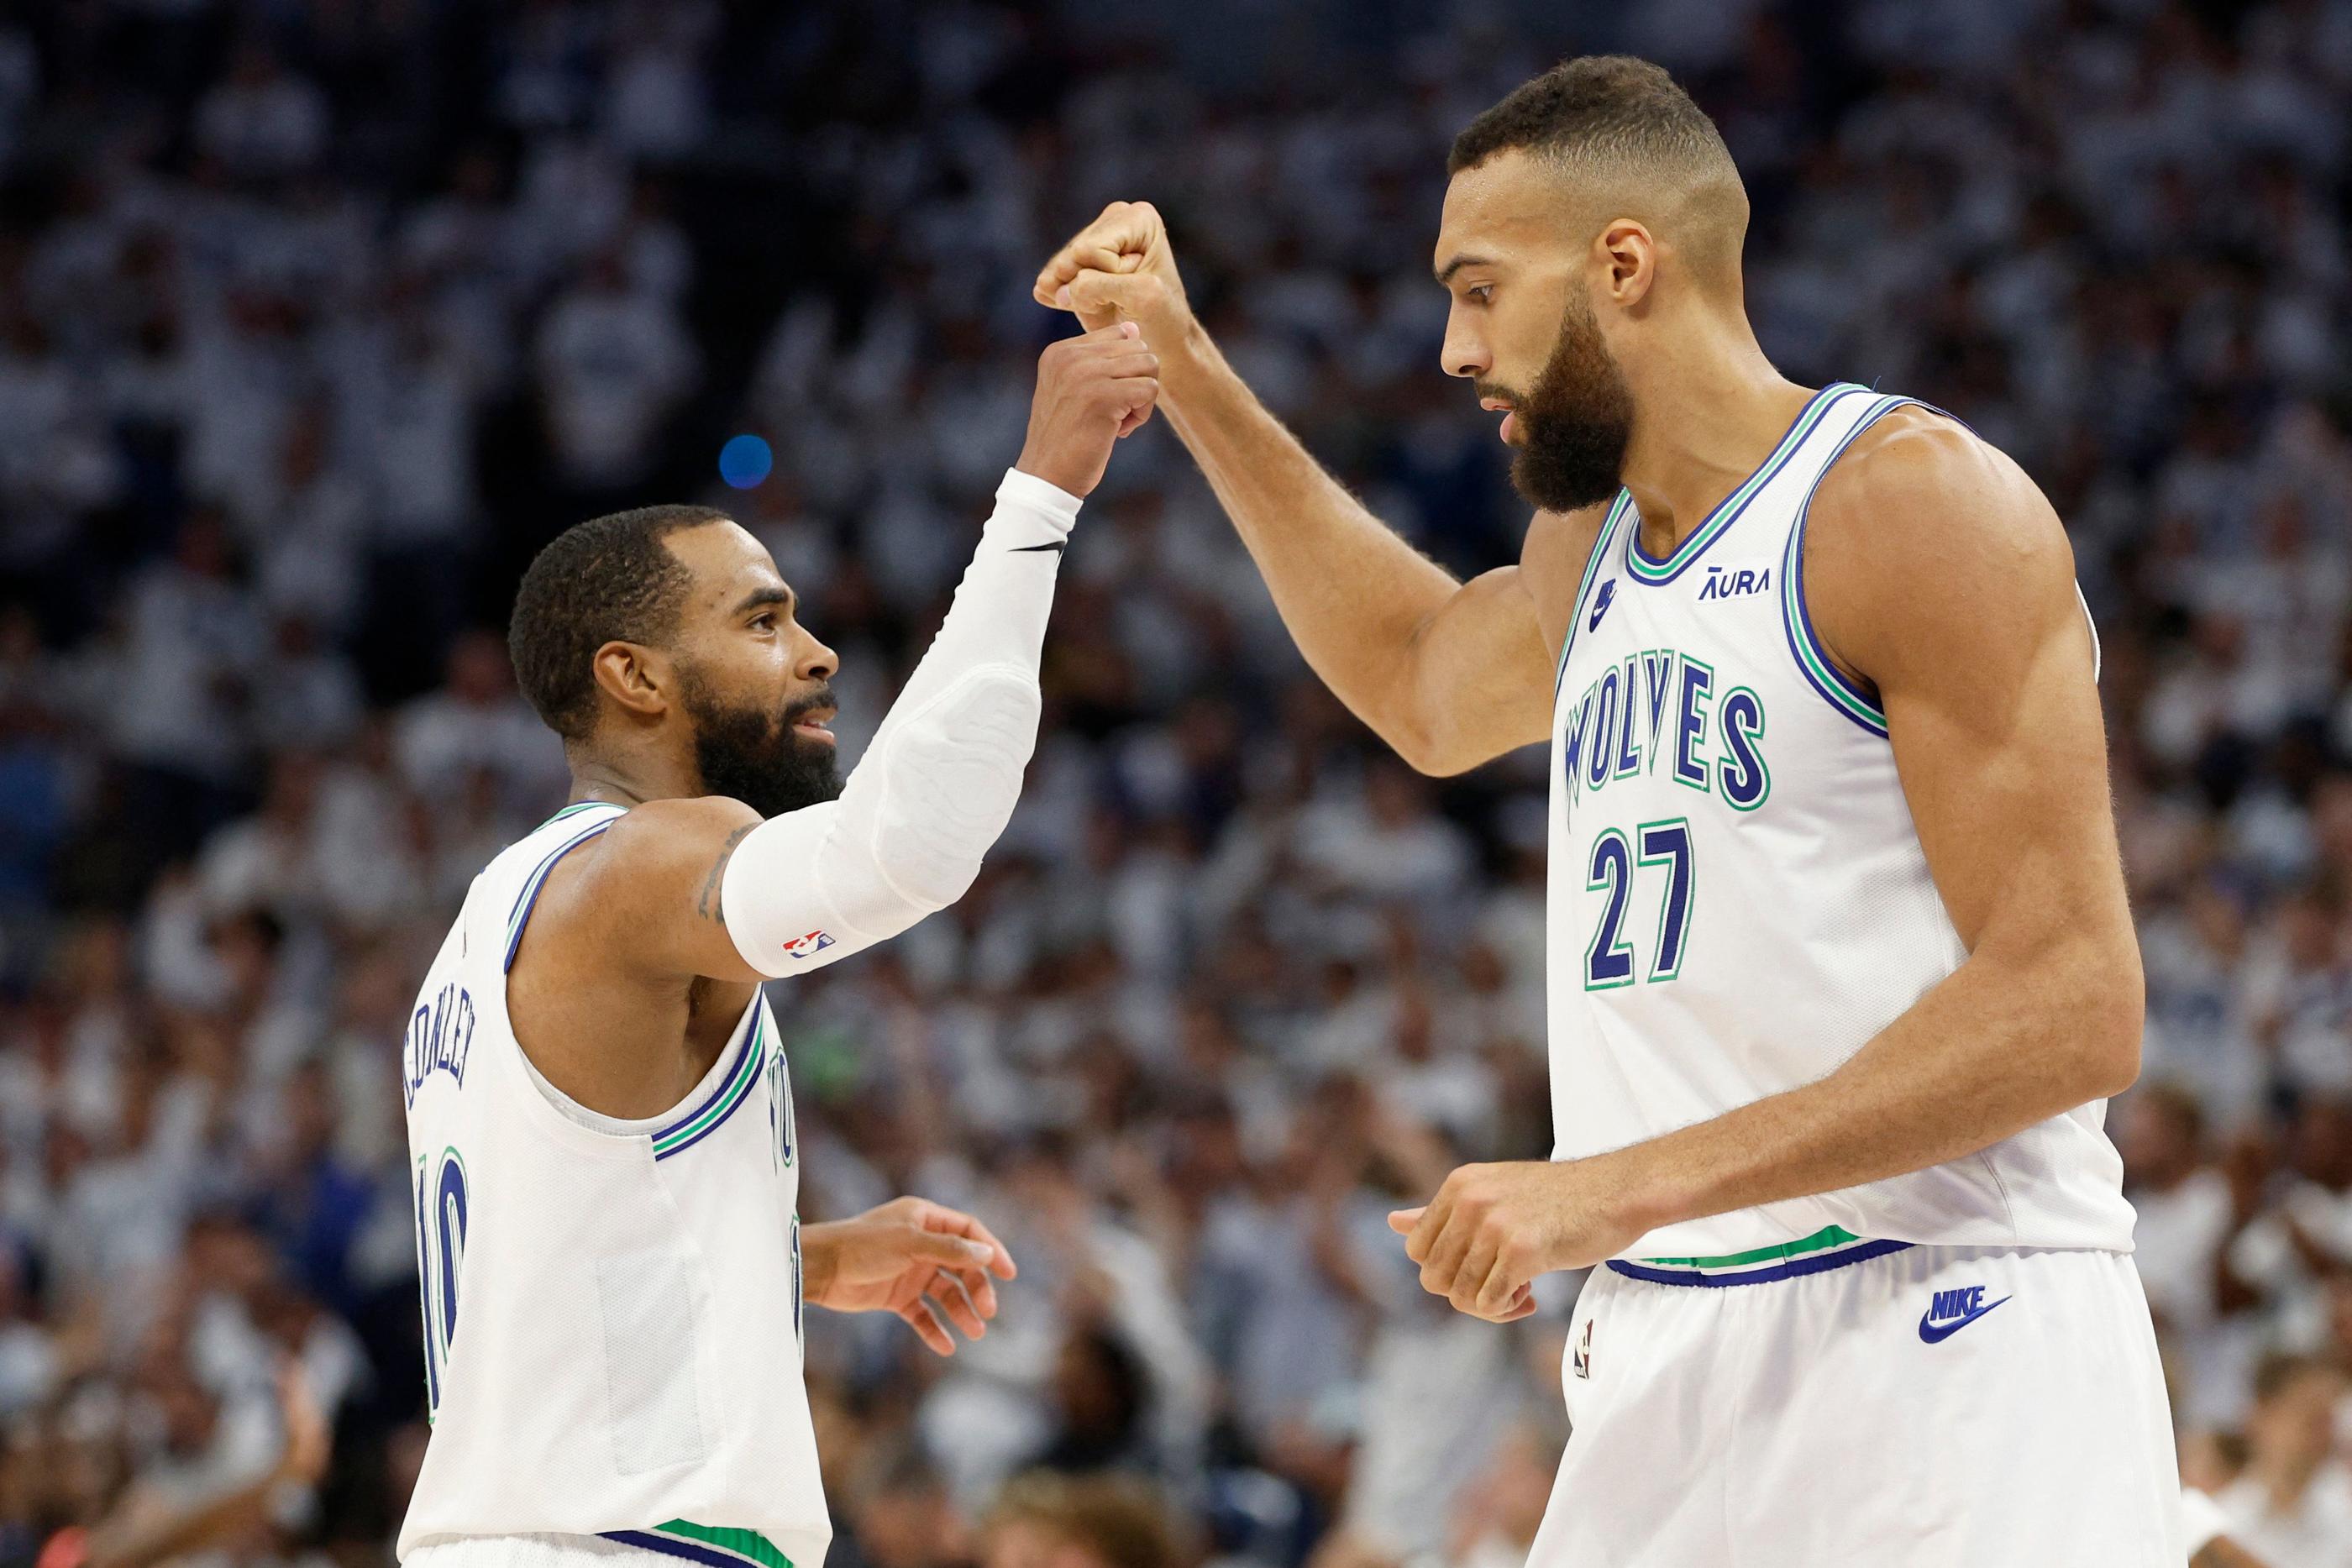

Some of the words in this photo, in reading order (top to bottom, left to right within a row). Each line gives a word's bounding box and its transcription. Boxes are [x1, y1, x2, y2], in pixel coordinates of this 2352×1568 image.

[1564, 648, 1771, 834] WOLVES
[1584, 816, 1695, 991] 27
[402, 983, 475, 1111] CONLEY
[418, 1146, 470, 1424] 10
[1929, 1286, 1986, 1321] NIKE
